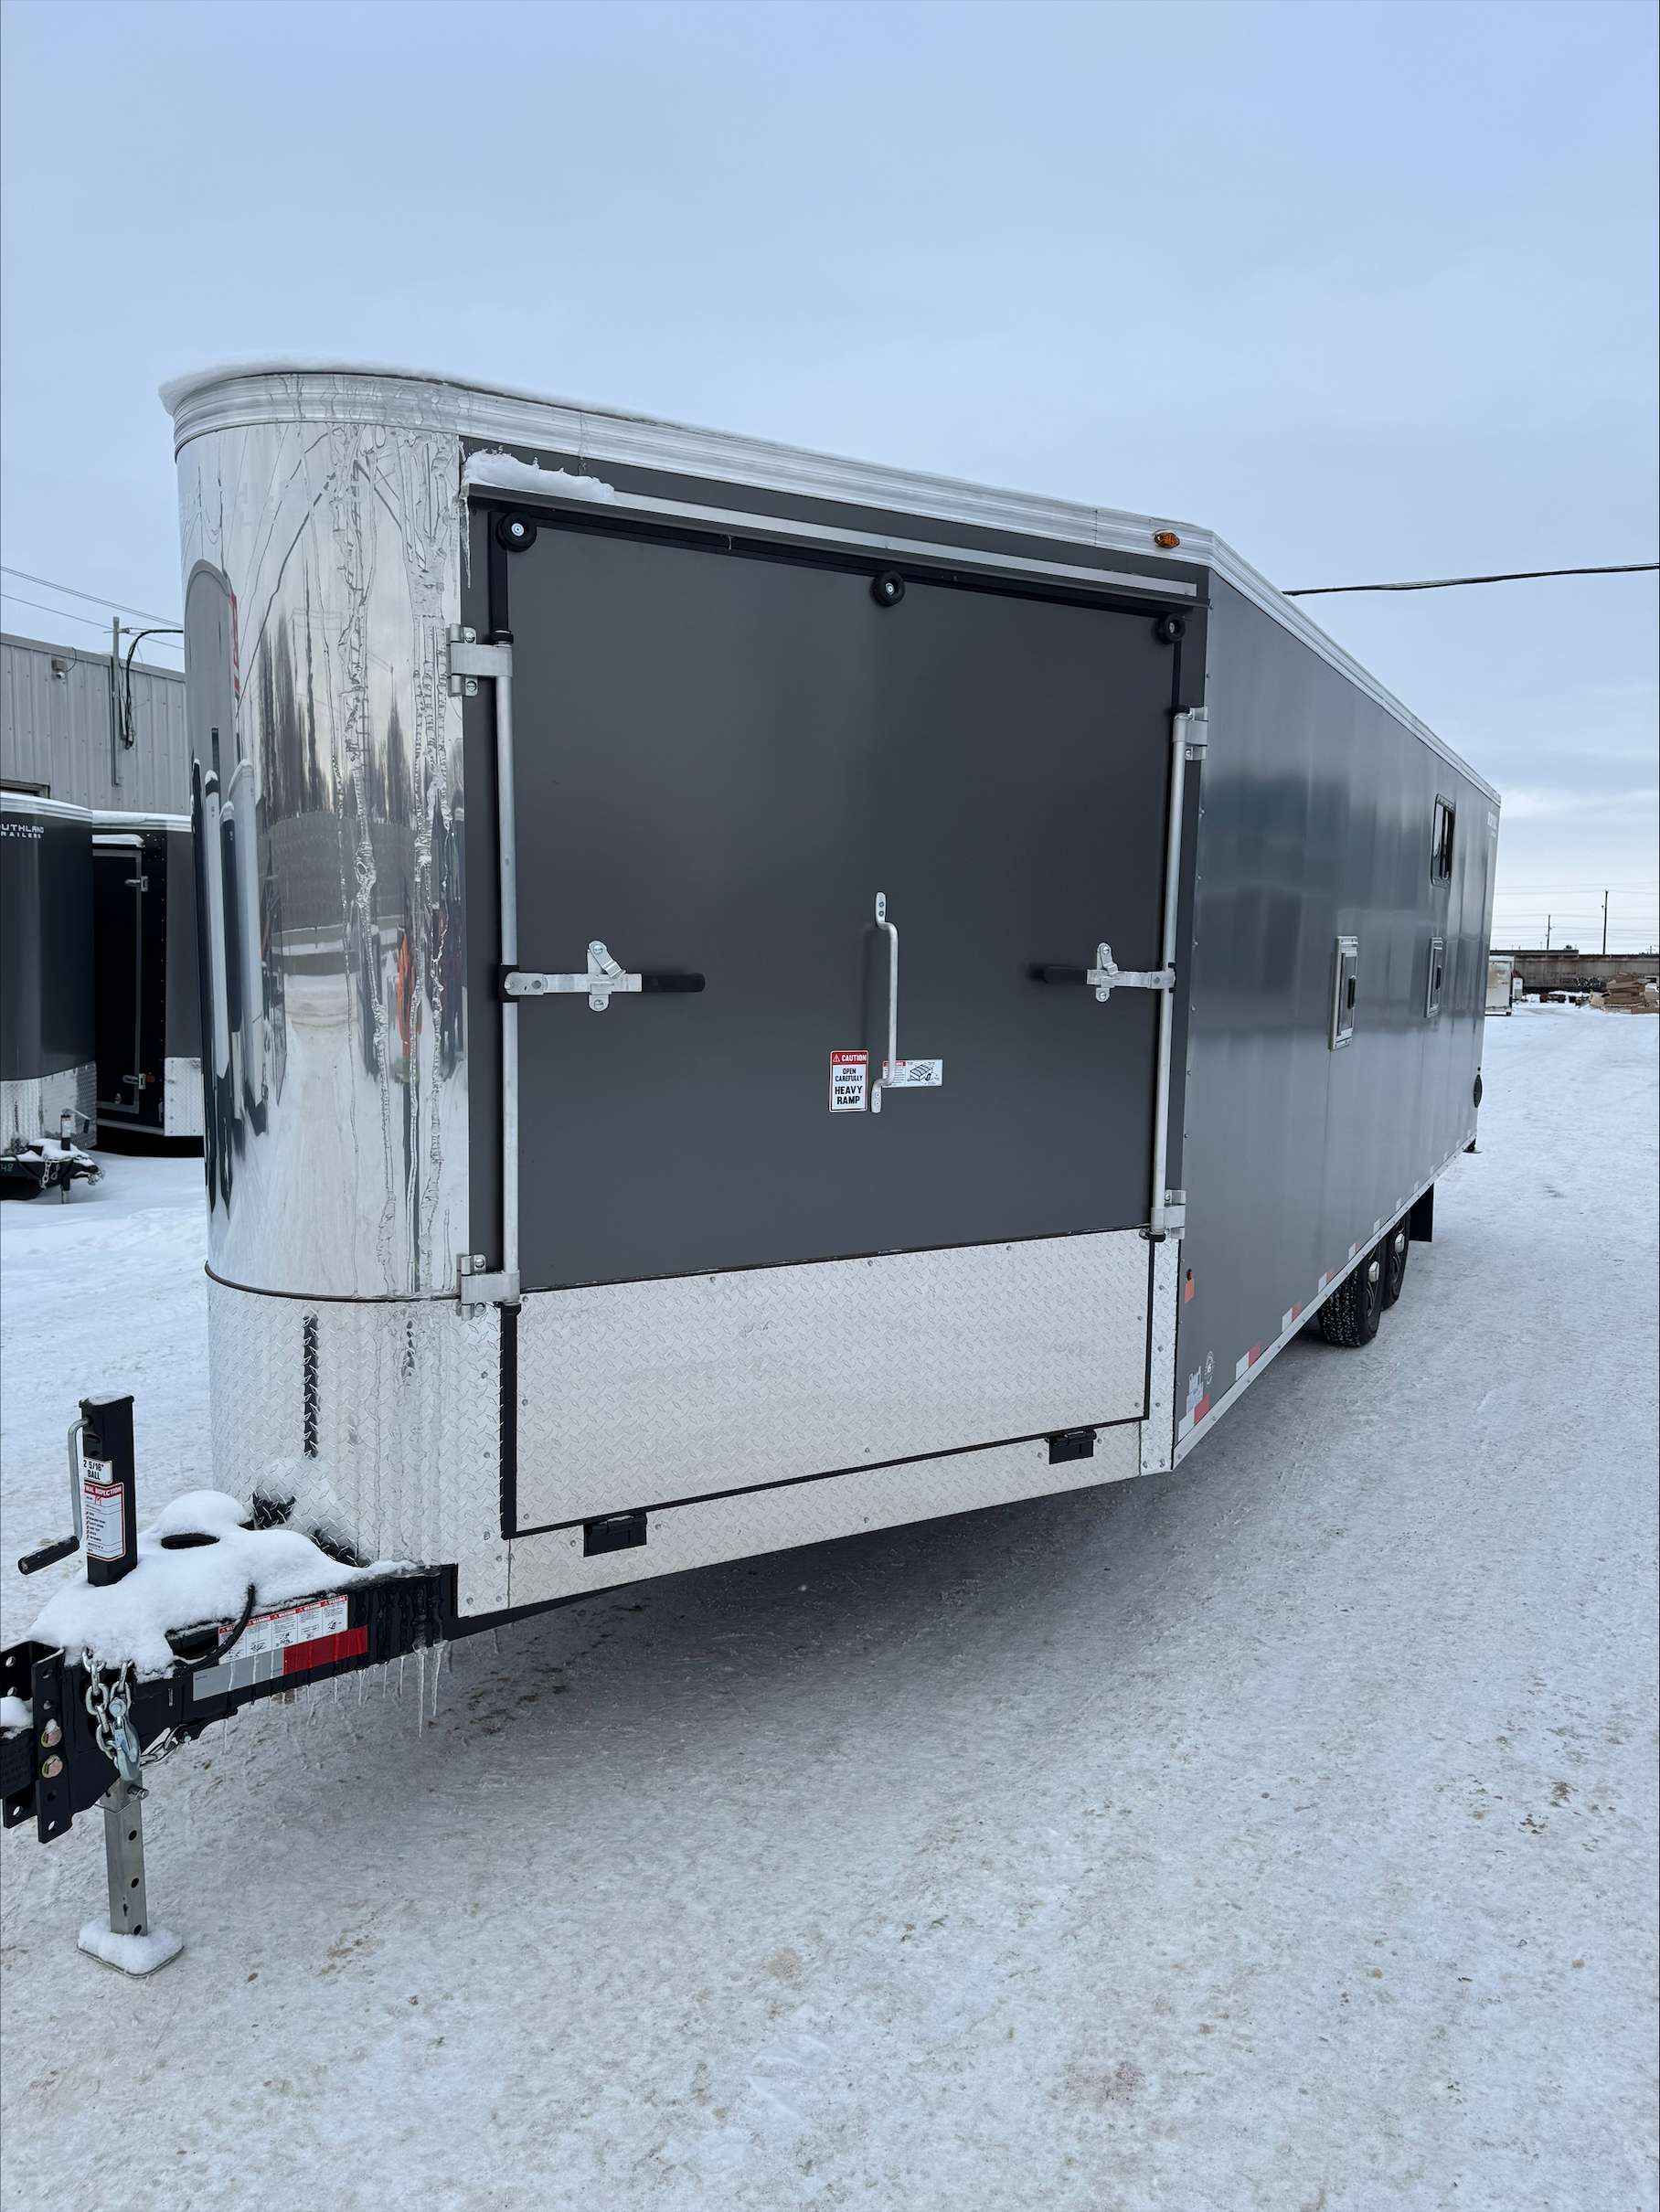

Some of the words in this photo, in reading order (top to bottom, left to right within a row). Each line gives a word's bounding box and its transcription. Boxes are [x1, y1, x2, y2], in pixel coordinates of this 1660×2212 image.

[0, 824, 44, 833] UTHLAND
[841, 1054, 867, 1062] CAUTION
[835, 1085, 863, 1095] HEAVY
[836, 1095, 860, 1105] RAMP
[87, 1469, 101, 1481] BALL
[94, 1486, 122, 1496] INSPECTION
